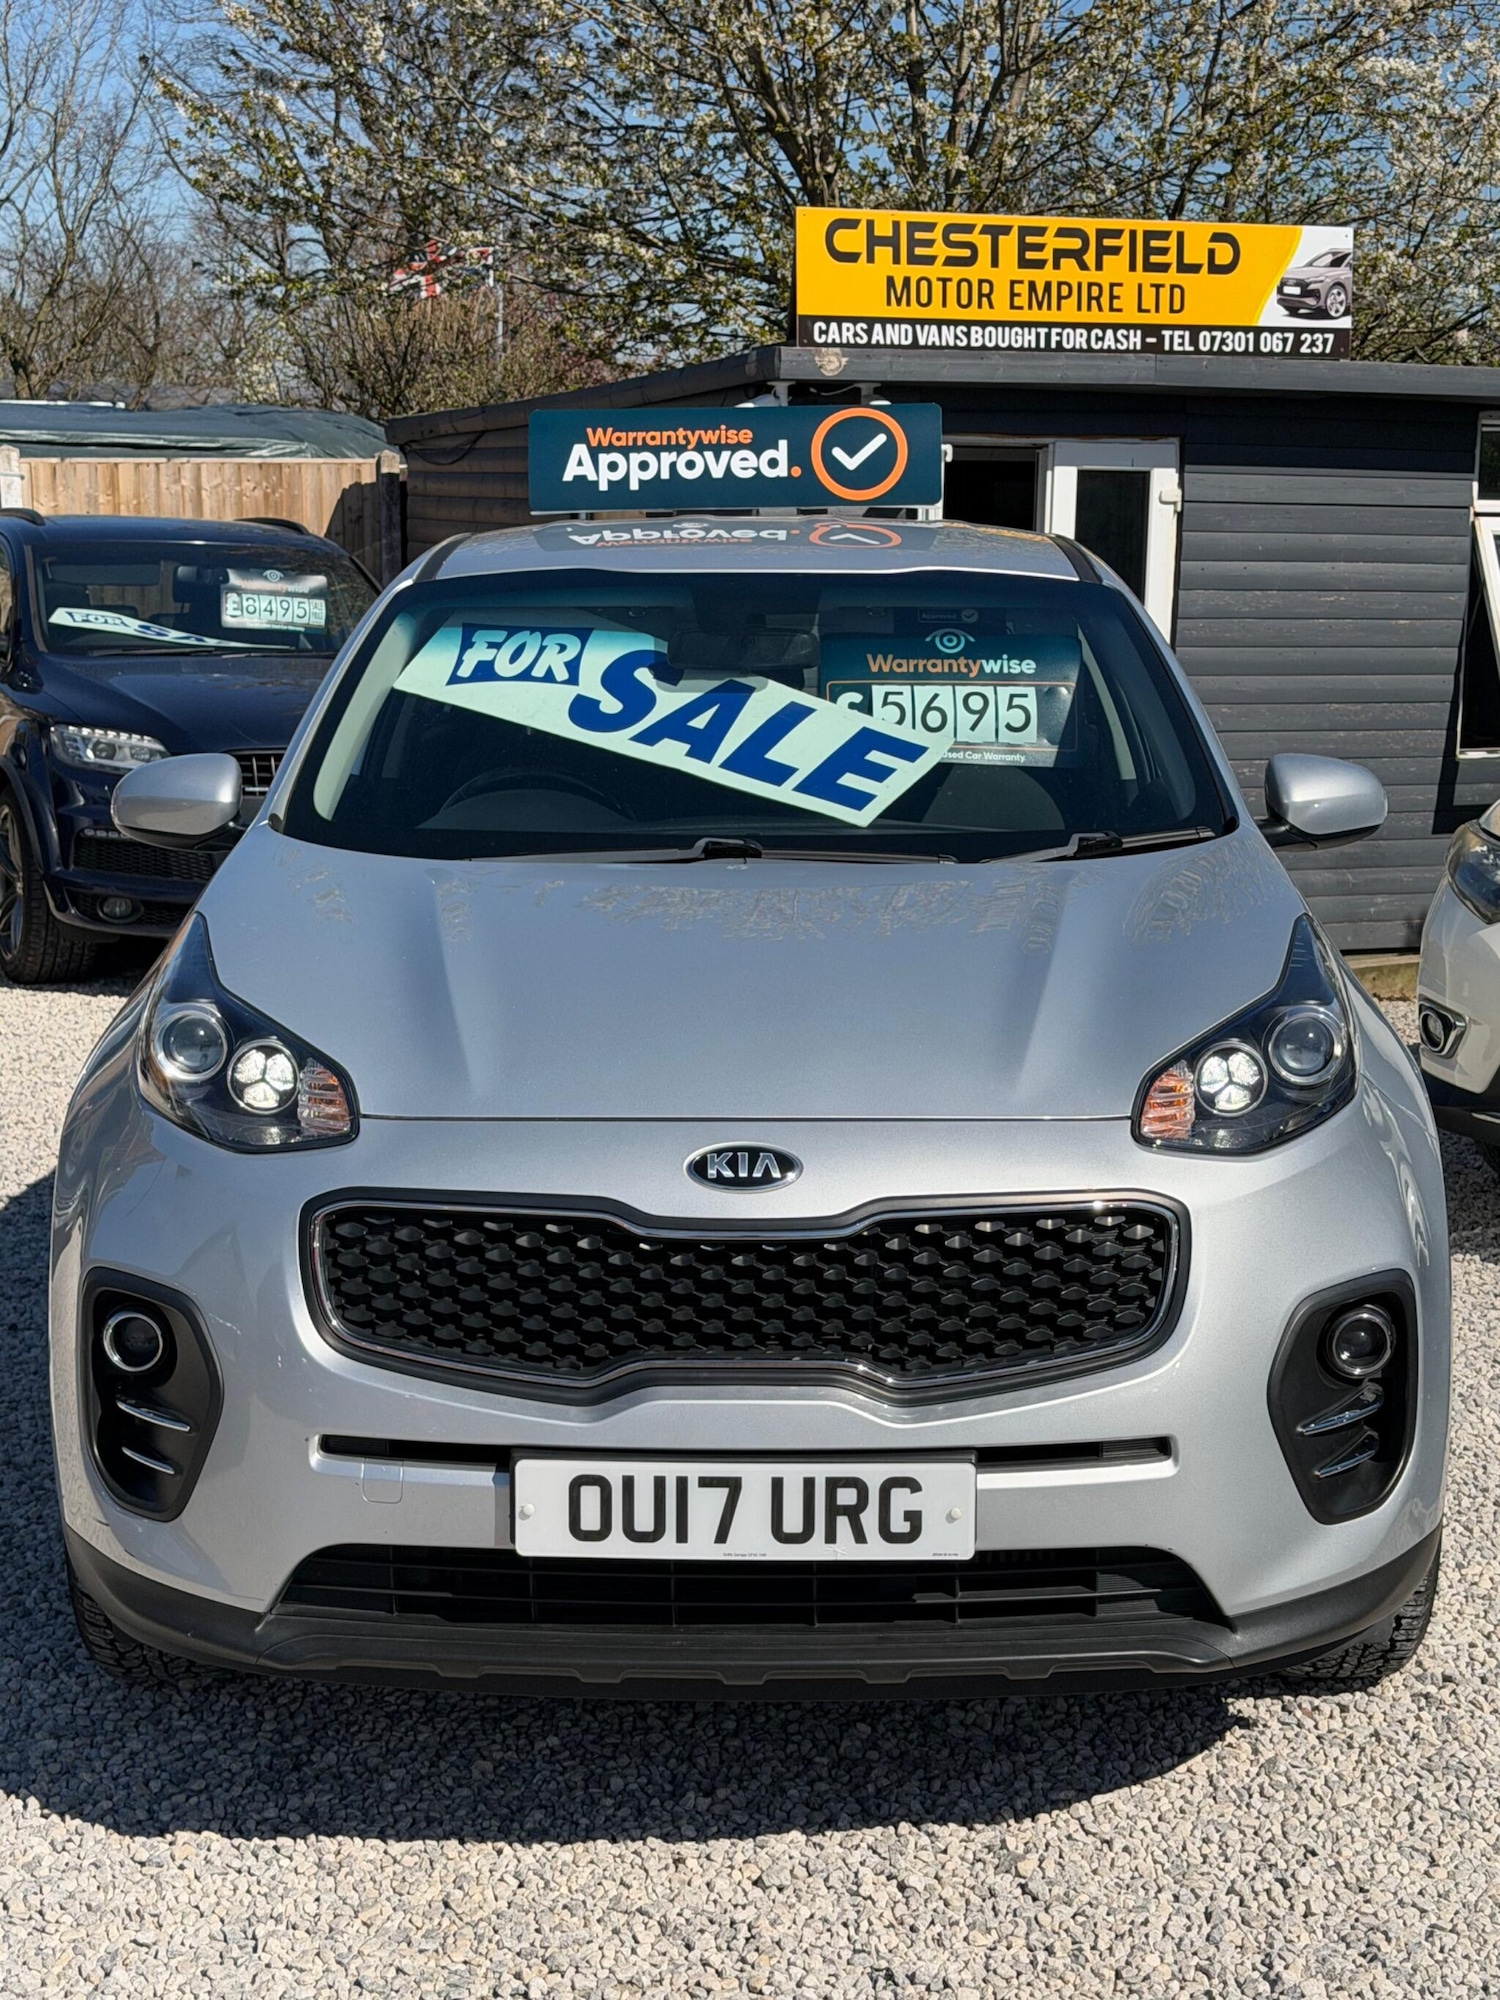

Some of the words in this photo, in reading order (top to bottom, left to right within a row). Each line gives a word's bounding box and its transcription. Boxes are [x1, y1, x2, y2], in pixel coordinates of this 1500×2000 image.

[824, 217, 1241, 275] CHESTERFIELD
[885, 275, 995, 308] MOTOR
[1008, 280, 1124, 313] EMPIRE
[1136, 283, 1186, 315] LTD
[812, 321, 869, 344] CARS
[871, 323, 914, 346] AND
[914, 324, 969, 347] VANS
[970, 326, 1048, 349] BOUGHT
[1050, 328, 1088, 349] FOR
[1090, 328, 1142, 350] CASH
[1161, 330, 1195, 351] TEL
[1198, 331, 1254, 352] 07301
[1259, 332, 1295, 353] 067
[1299, 333, 1335, 354] 237
[586, 424, 753, 450] Warrantywise
[73, 612, 121, 625] FOR
[866, 653, 1037, 678] Warrantywise
[456, 630, 582, 682] FOR
[568, 650, 930, 812] SALE
[965, 751, 981, 759] Car
[707, 1152, 781, 1178] KIA
[568, 1474, 742, 1543] OU17
[771, 1476, 923, 1544] URG
